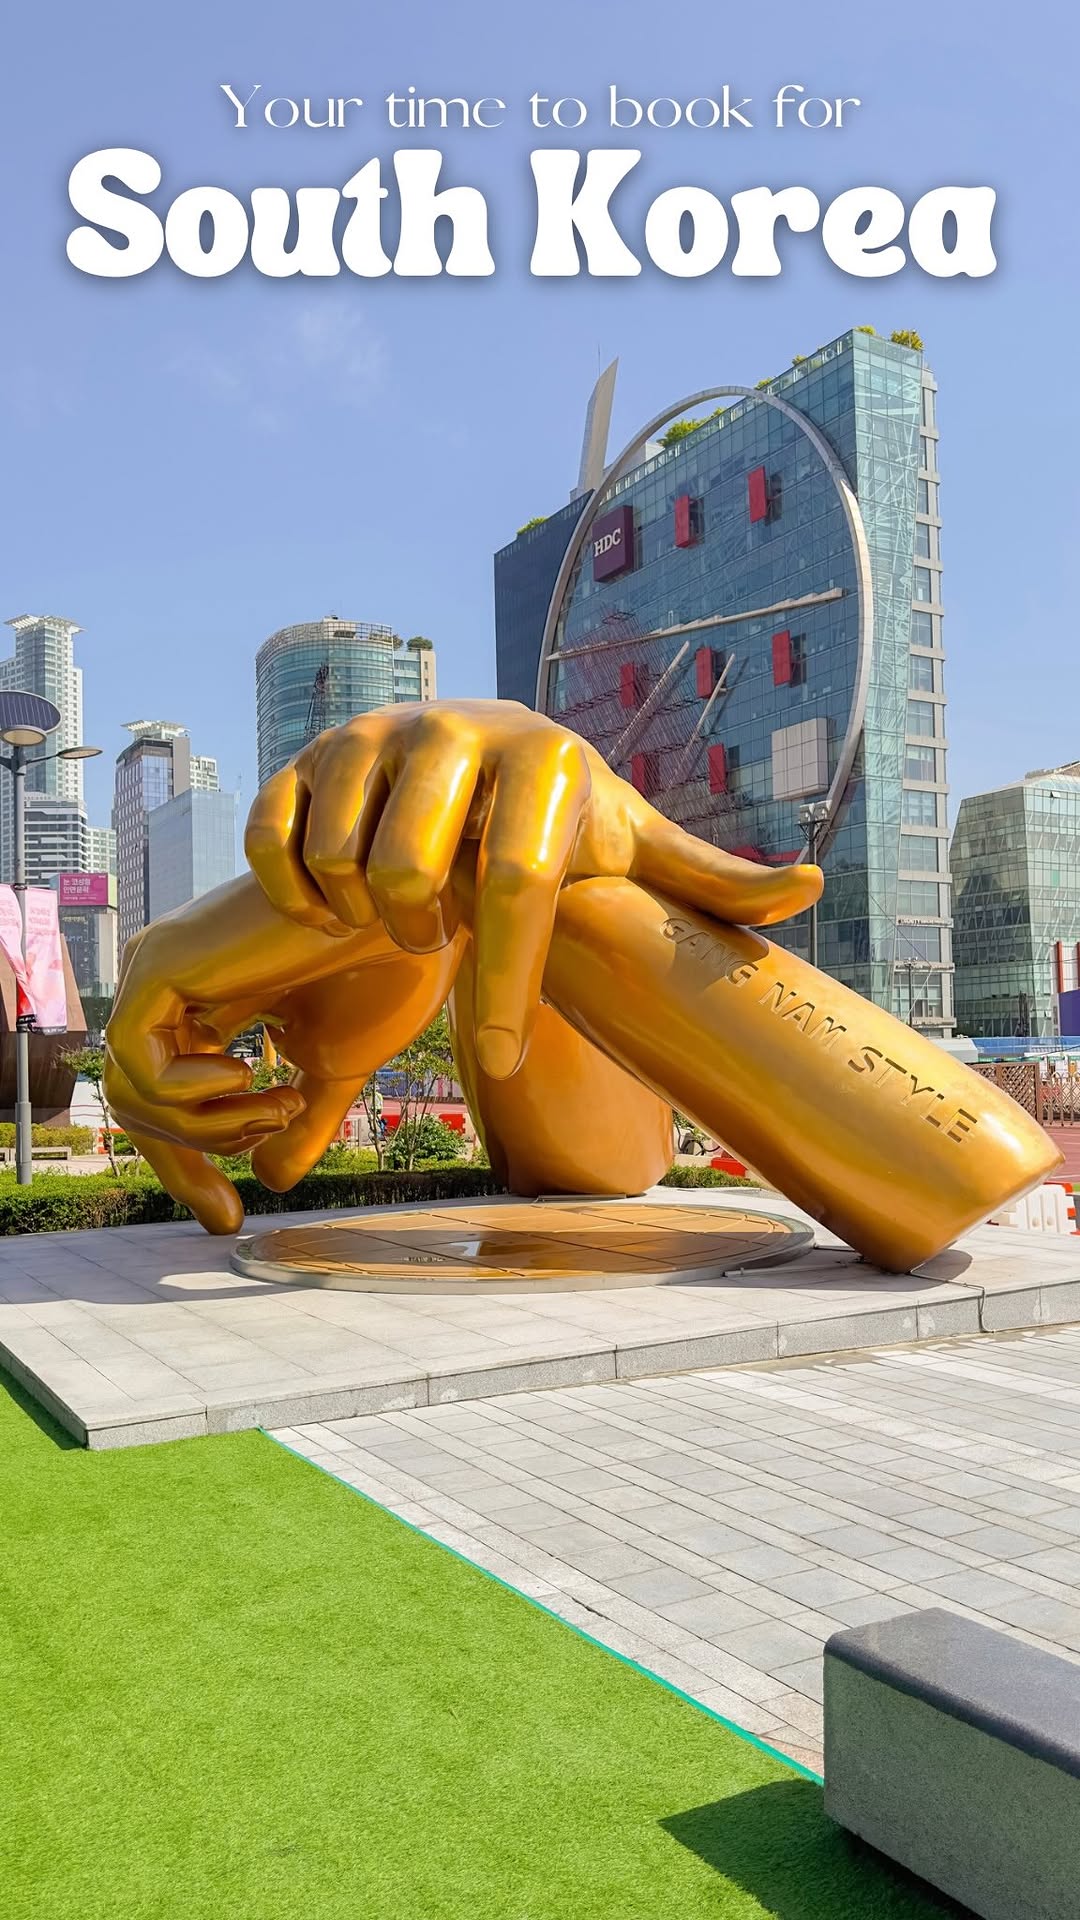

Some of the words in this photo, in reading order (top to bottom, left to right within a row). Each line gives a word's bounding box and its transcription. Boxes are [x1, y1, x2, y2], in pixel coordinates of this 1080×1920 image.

[594, 528, 621, 557] HDC
[659, 917, 760, 988] GANG
[757, 981, 848, 1051] NAM
[847, 1046, 978, 1144] STYLE
